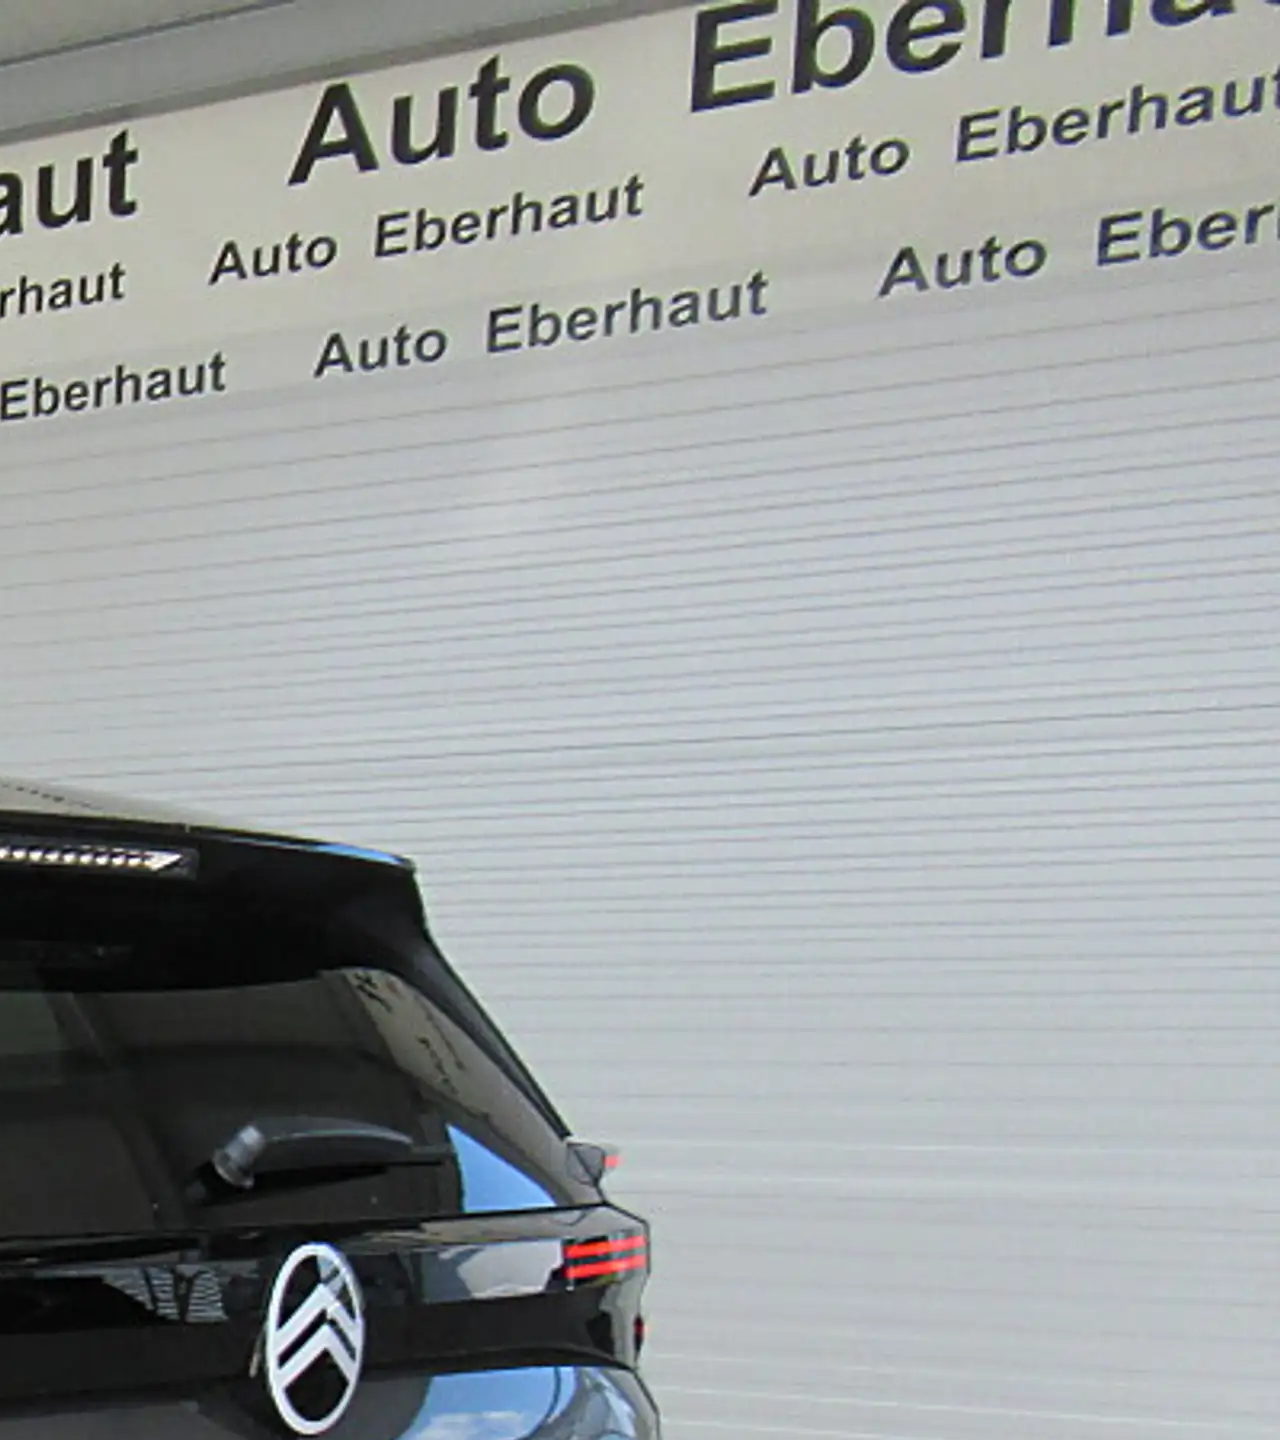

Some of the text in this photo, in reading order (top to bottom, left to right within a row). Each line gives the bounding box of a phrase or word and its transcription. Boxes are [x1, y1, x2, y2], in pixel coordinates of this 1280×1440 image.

[288, 55, 594, 186] Auto
[748, 68, 1280, 197] Auto Eberhau
[209, 175, 644, 285] Auto Eberhaut
[879, 204, 1280, 297] Auto Eber
[314, 272, 767, 378] Auto Eberhaut
[0, 352, 226, 421] Eberhaut
